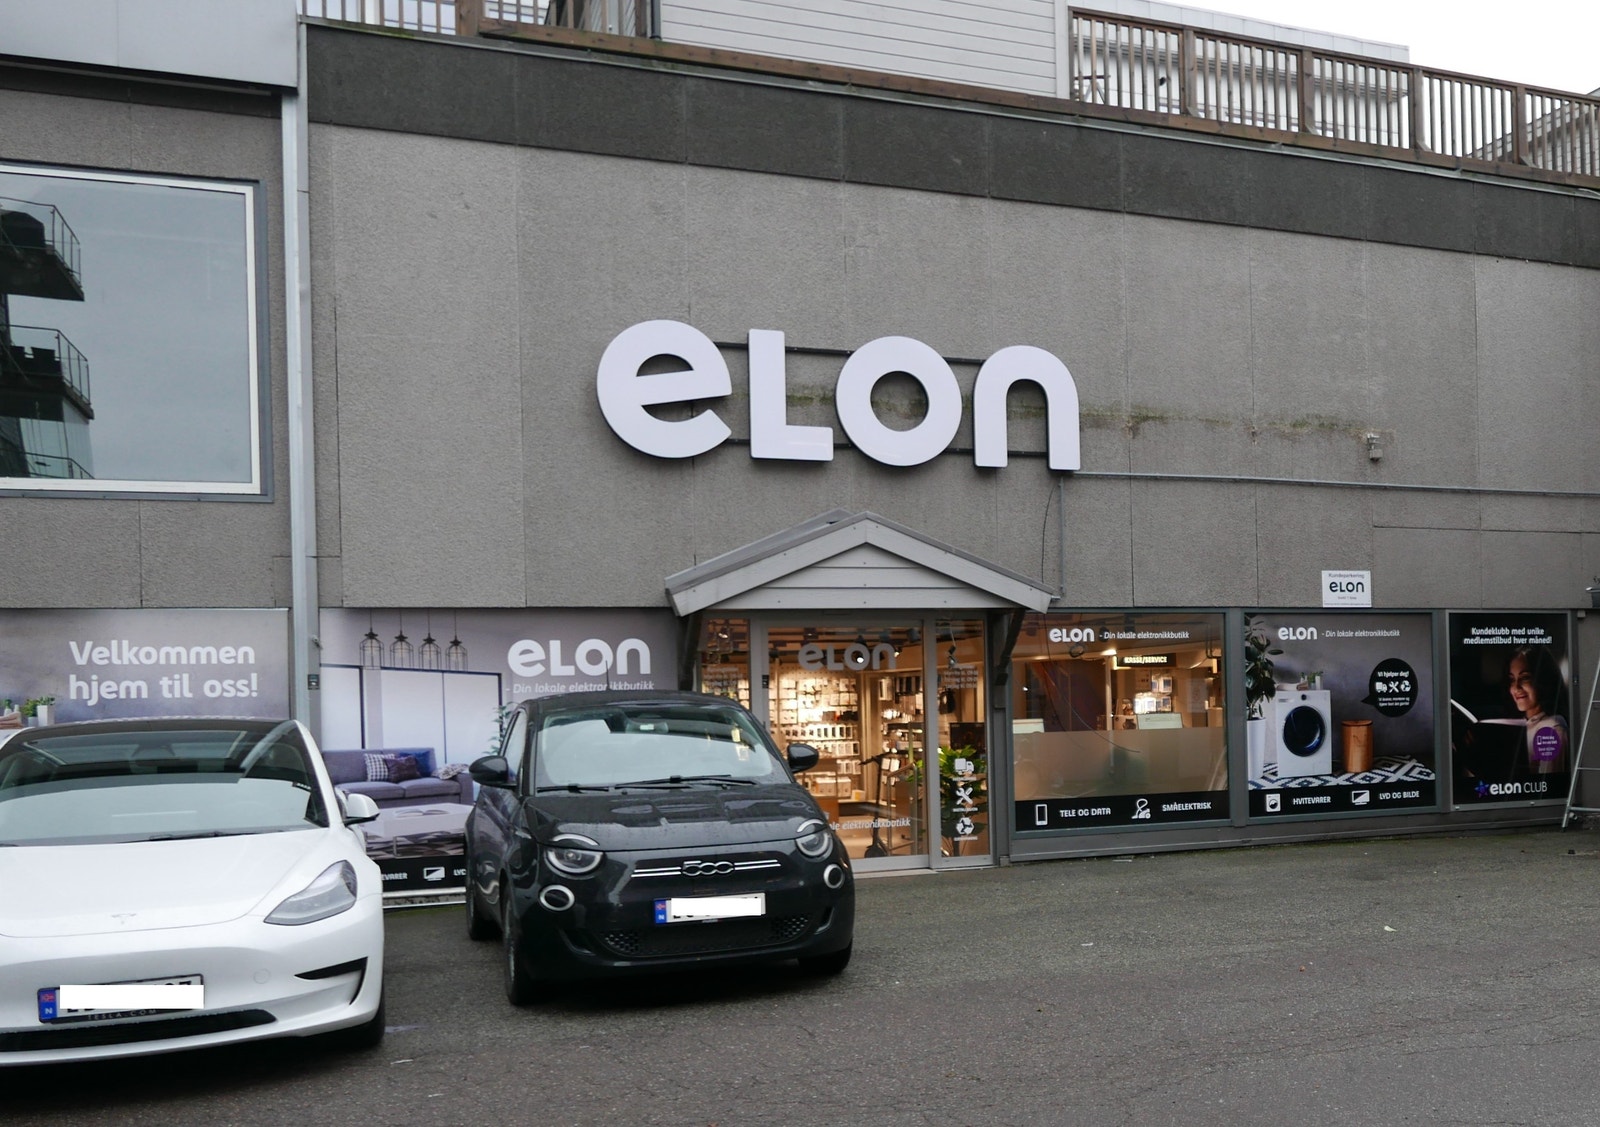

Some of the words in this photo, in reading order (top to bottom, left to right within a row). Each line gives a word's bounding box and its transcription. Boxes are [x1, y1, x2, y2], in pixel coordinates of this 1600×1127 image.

[1104, 631, 1116, 639] Din
[1117, 631, 1136, 639] lokale
[1137, 630, 1190, 639] elektronikkbutikk
[1355, 629, 1400, 637] elektronikkbutikk
[1471, 627, 1510, 635] Kundeklubb
[1511, 627, 1525, 635] med
[1527, 627, 1544, 635] unike
[1463, 636, 1512, 645] medlemstilbud
[1513, 635, 1527, 644] hver
[1528, 635, 1553, 644] måned!
[68, 640, 255, 666] Velkommen
[69, 674, 148, 706] hjem
[159, 673, 193, 698] til
[203, 673, 258, 698] oss!
[513, 683, 532, 694] Din
[535, 683, 566, 693] lokale
[1523, 781, 1548, 793] CLUB
[1379, 792, 1391, 800] LYD
[1392, 791, 1401, 799] OG
[1402, 790, 1420, 798] BILDE
[1293, 796, 1331, 805] HVITEVARER
[1162, 802, 1212, 812] SMÅELEKTRISK
[1060, 809, 1076, 818] TELE
[1078, 808, 1089, 817] OG
[1091, 807, 1112, 816] DATA
[682, 860, 734, 876] 500
